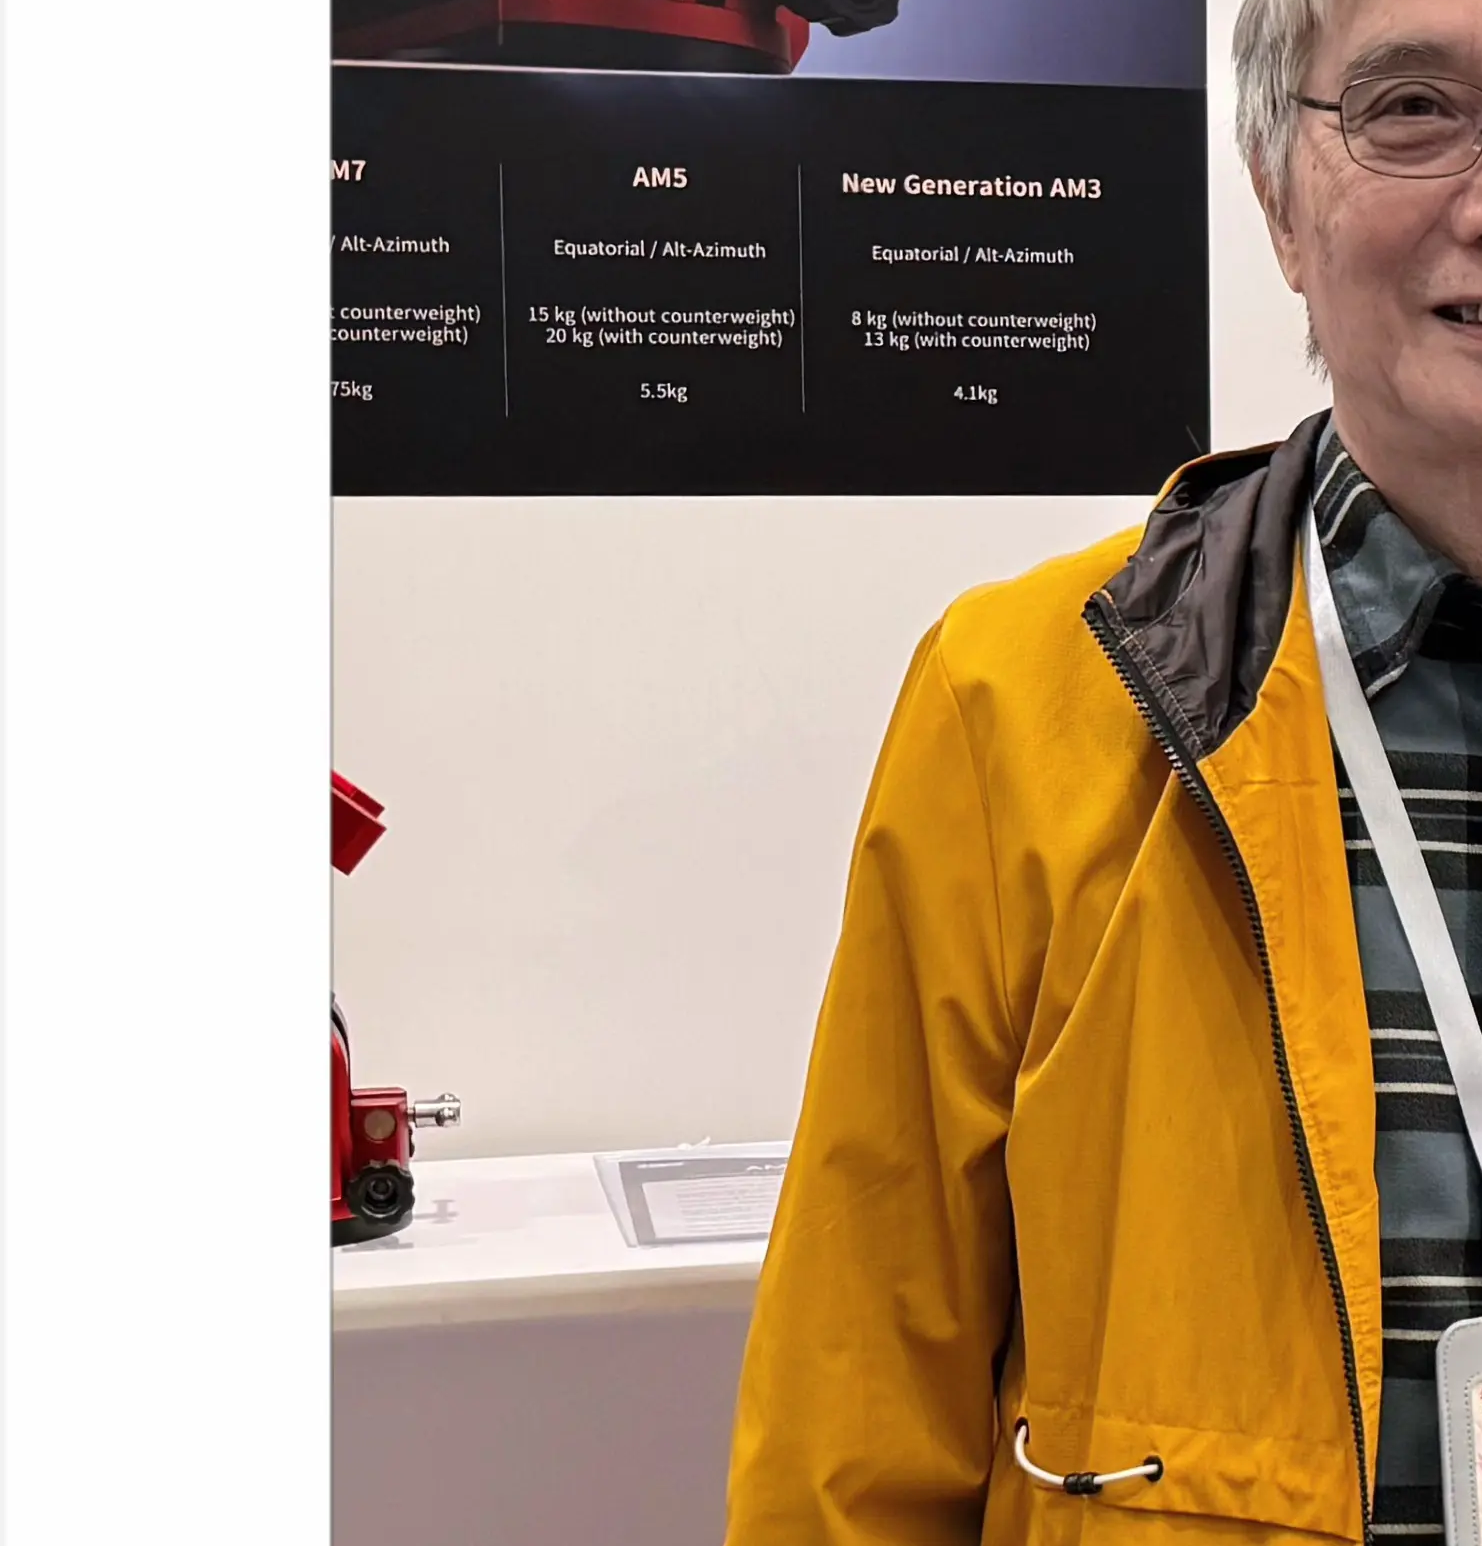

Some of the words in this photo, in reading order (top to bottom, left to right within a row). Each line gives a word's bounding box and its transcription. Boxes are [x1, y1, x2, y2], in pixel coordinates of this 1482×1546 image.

[633, 167, 687, 188] AM5
[843, 173, 896, 193] New
[904, 175, 1042, 197] Generation
[1050, 178, 1101, 198] AM3
[341, 235, 449, 252] Alt-Azimuth
[555, 240, 644, 258] Equatorial
[663, 241, 765, 258] Alt-Azimuth
[872, 246, 958, 264] Equatorial
[976, 247, 1073, 263] Alt-Azimuth
[341, 305, 480, 324] counterweight)
[530, 307, 549, 322] 15
[555, 306, 576, 326] kg
[582, 306, 655, 325] (without
[661, 309, 794, 328] counterweight)
[852, 311, 861, 325] 8
[868, 311, 887, 330] kg
[893, 311, 963, 328] (without
[968, 313, 1096, 332] counterweight)
[546, 328, 566, 343] 20
[573, 327, 593, 347] kg
[599, 328, 642, 346] (with
[649, 330, 782, 349] counterweight)
[865, 332, 883, 346] 13
[890, 331, 909, 351] kg
[915, 332, 956, 349] (with
[962, 333, 1089, 352] counterweight)
[641, 383, 687, 402] 5.5kg
[954, 385, 997, 404] 4.1kg
